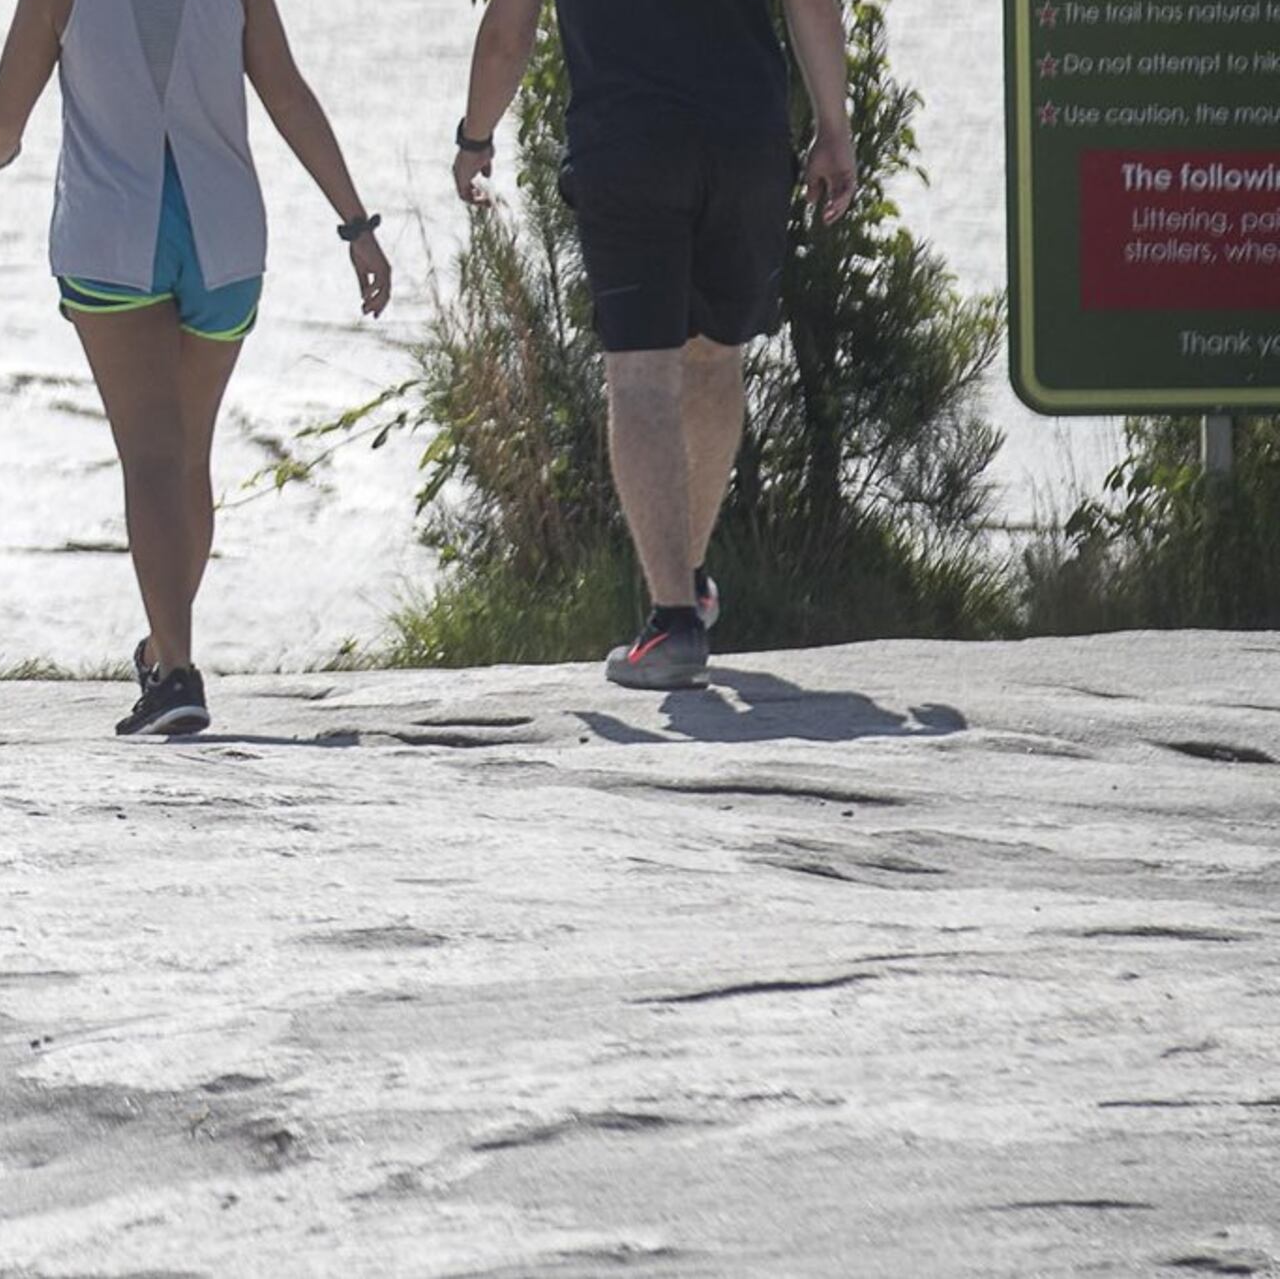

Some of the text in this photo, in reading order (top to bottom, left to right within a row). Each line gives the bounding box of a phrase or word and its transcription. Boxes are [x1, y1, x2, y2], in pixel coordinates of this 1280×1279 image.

[1062, 1, 1100, 24] The
[1105, 0, 1142, 24] trail
[1147, 1, 1183, 23] has
[1187, 0, 1260, 23] natural
[1063, 52, 1094, 74] Do
[1098, 52, 1132, 74] not
[1137, 51, 1220, 78] attempt
[1226, 52, 1249, 73] to
[1063, 104, 1100, 125] Use
[1104, 103, 1190, 127] caution,
[1196, 103, 1229, 125] the
[1122, 163, 1172, 191] The
[1132, 206, 1234, 236] Littering,
[1124, 239, 1217, 264] strollers,
[1180, 330, 1250, 355] Thank
